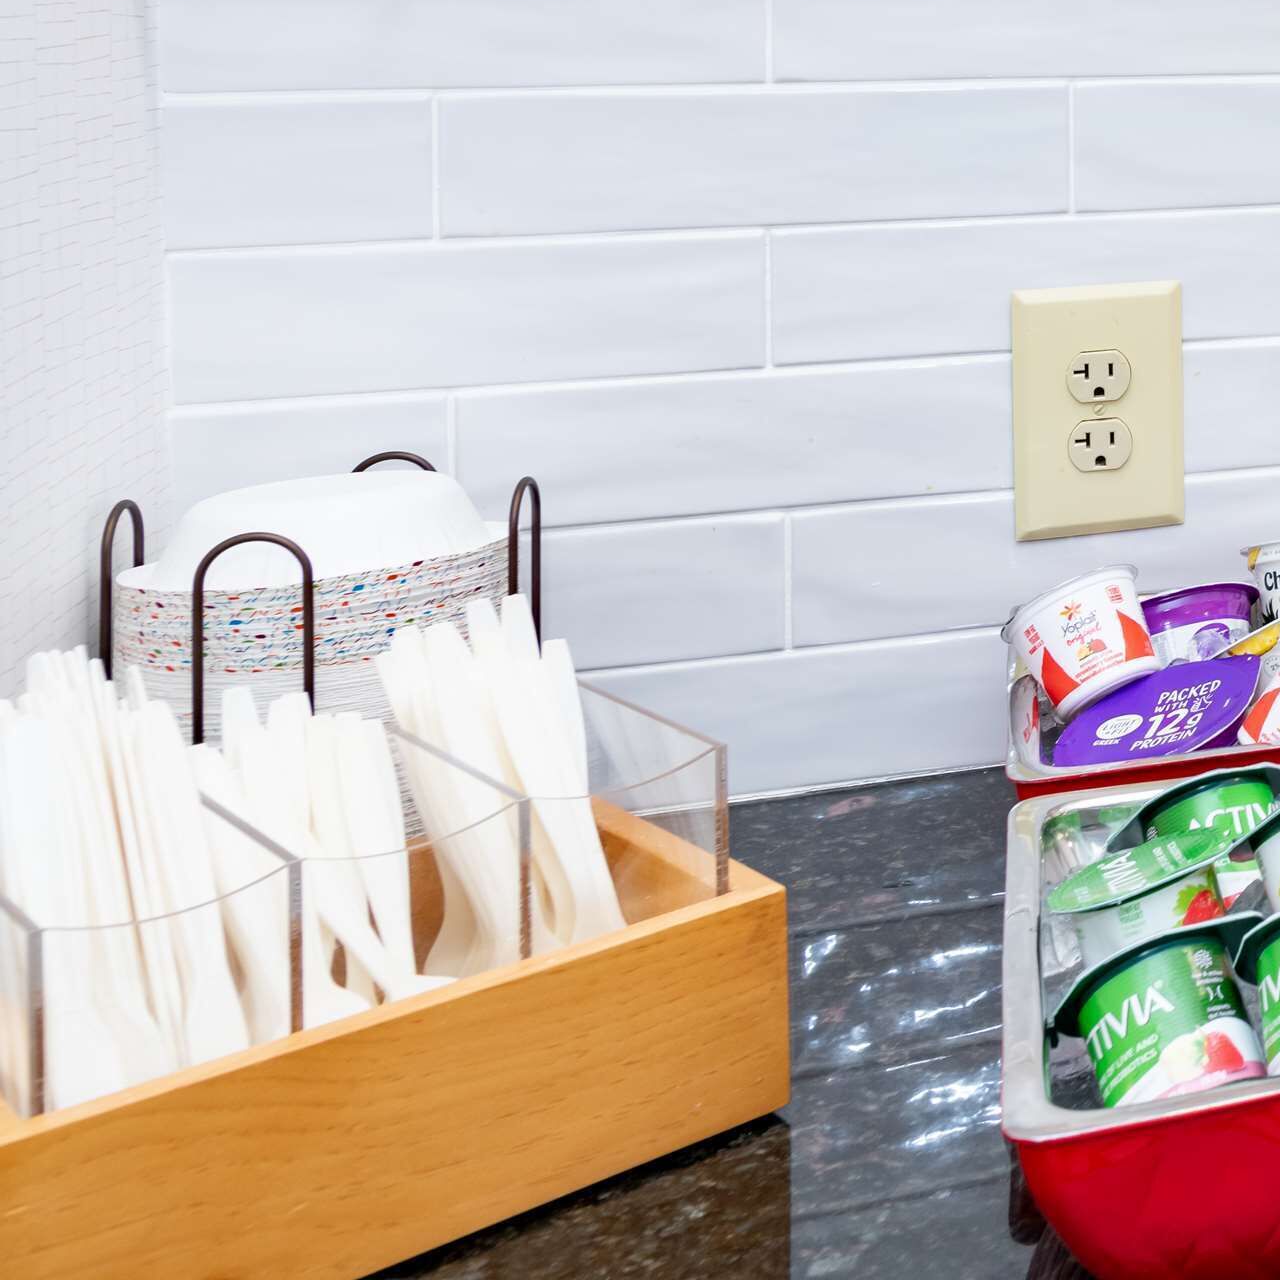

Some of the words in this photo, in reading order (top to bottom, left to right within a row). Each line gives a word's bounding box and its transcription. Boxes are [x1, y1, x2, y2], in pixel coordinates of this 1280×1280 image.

[1158, 679, 1222, 705] PACKED
[1153, 700, 1189, 713] WITH
[1129, 727, 1198, 751] PROTEIN
[1086, 984, 1176, 1061] TIVIA
